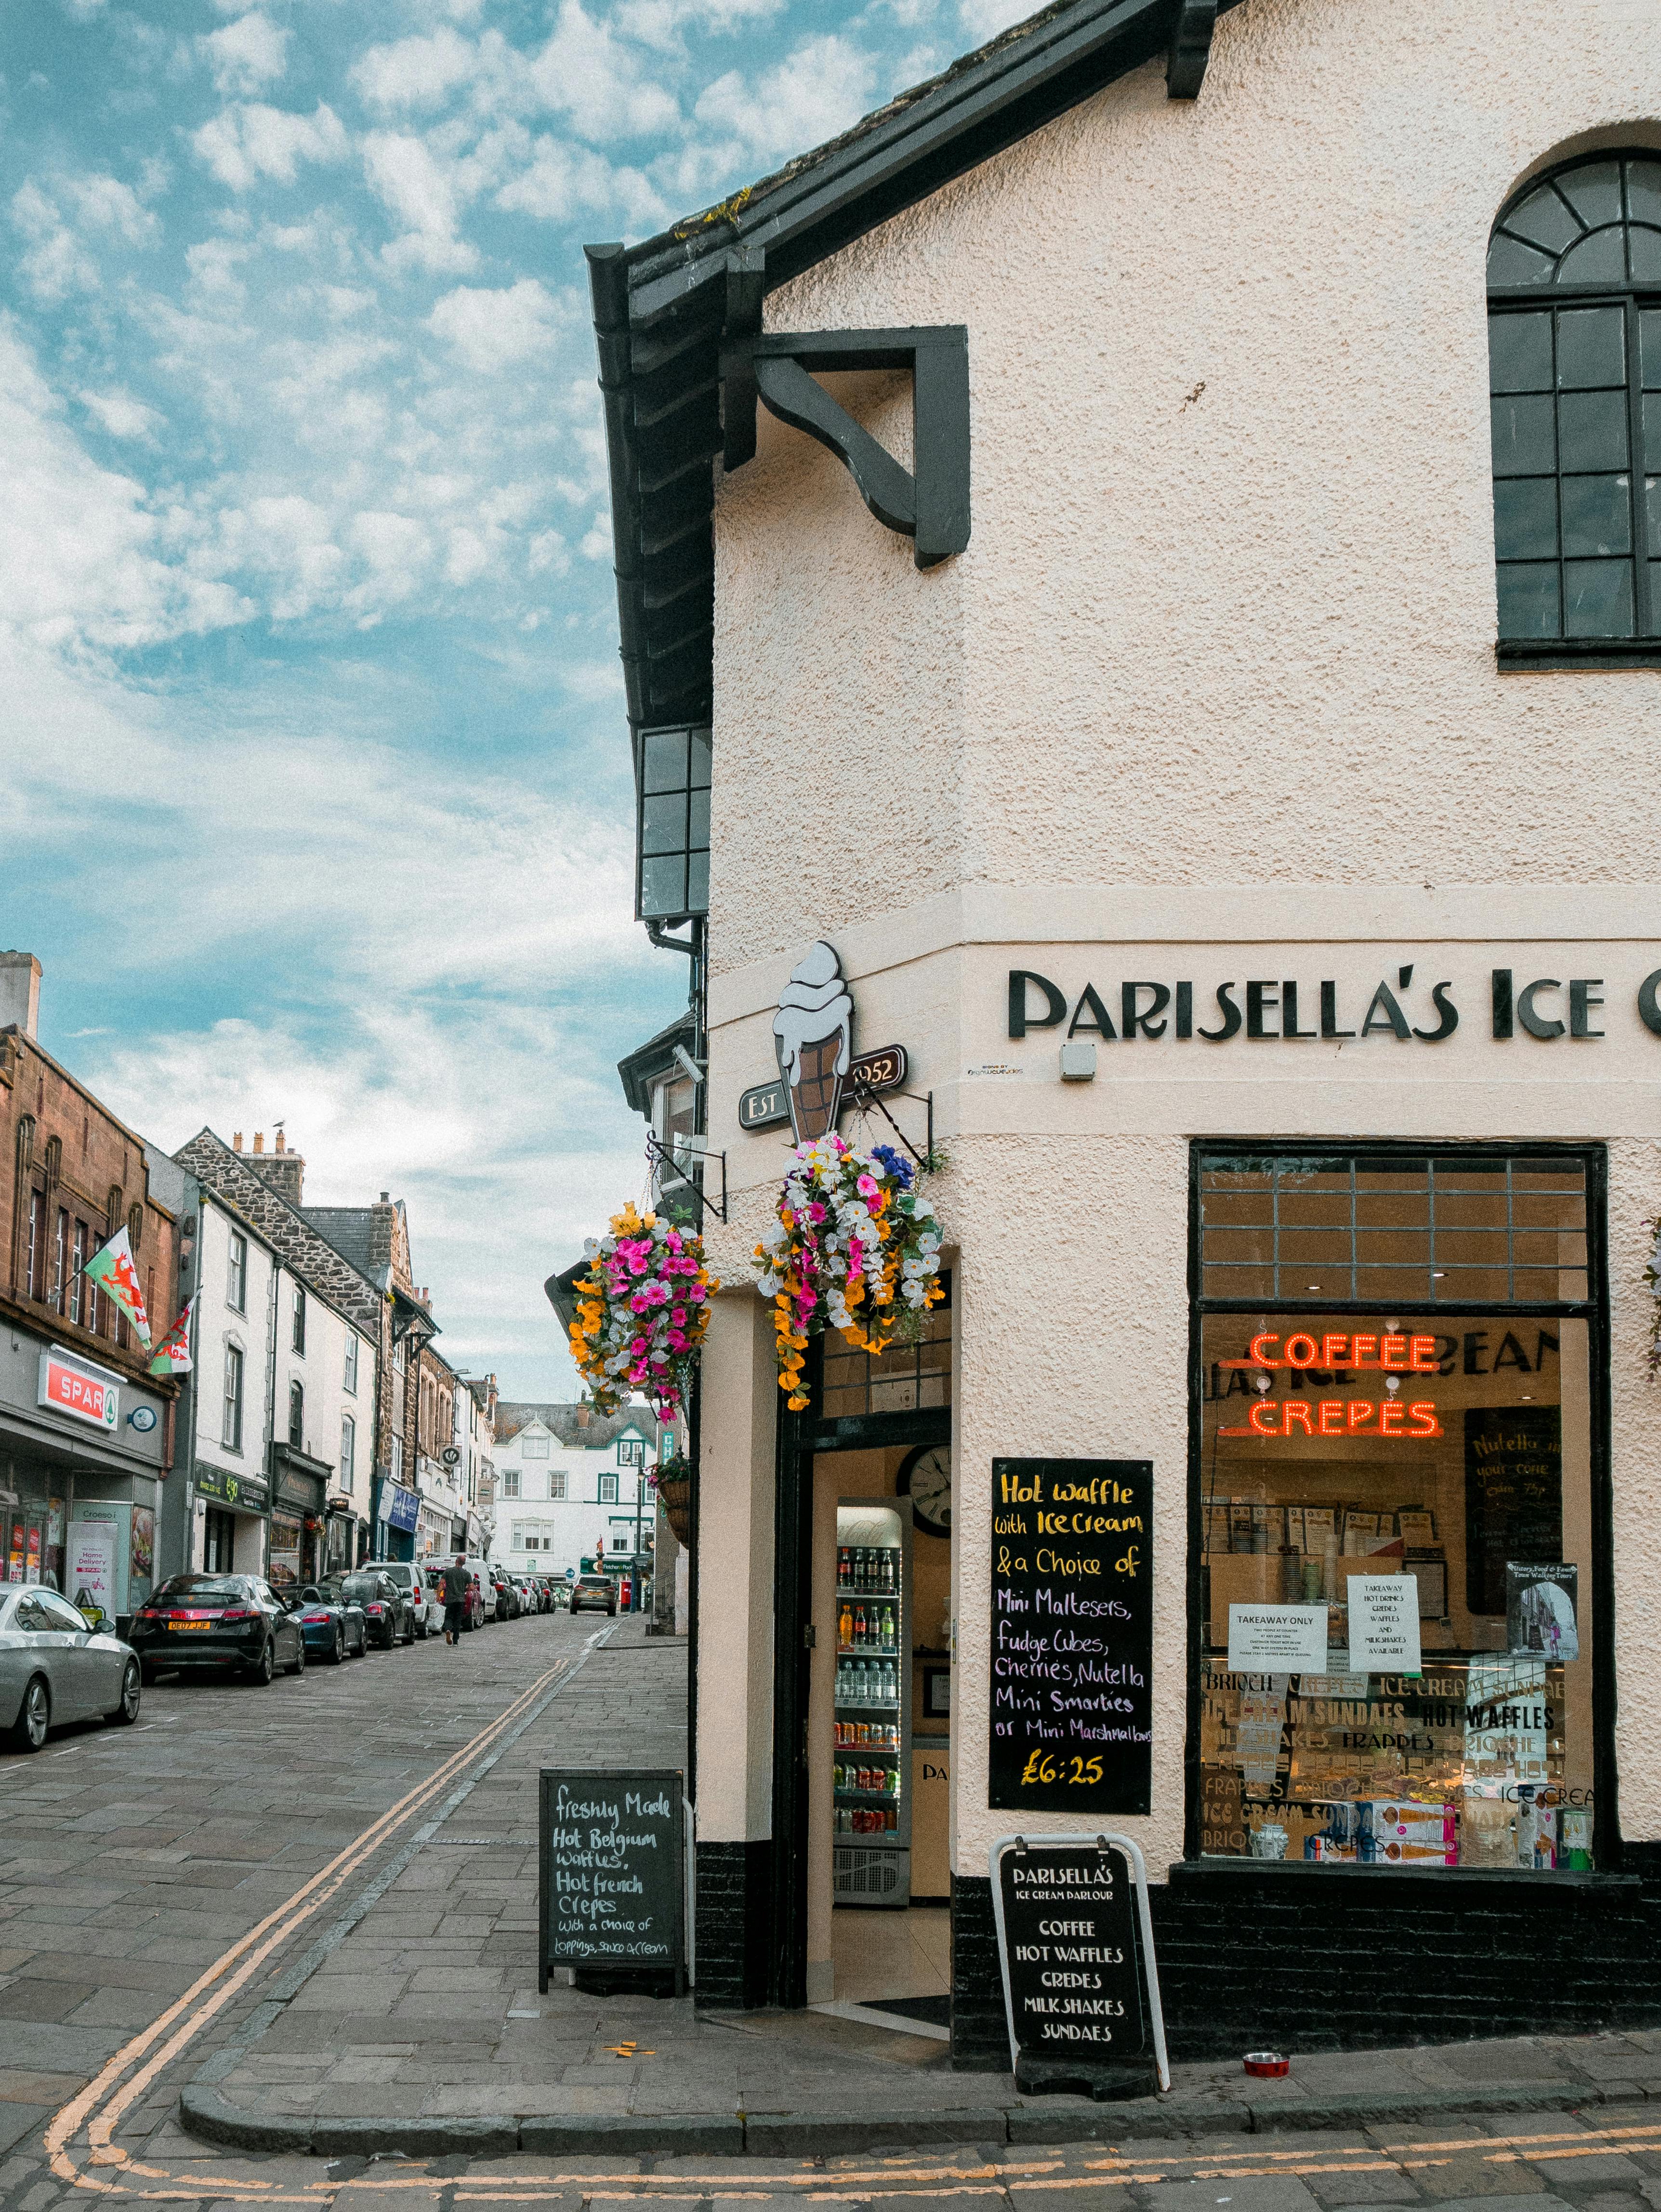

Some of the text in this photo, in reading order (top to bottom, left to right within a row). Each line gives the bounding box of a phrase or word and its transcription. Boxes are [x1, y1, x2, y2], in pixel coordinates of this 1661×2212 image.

[1008, 964, 1459, 1040] PARISELLA'S
[1492, 969, 1606, 1039] ICE
[1250, 1333, 1436, 1371] COFFEE
[61, 1375, 103, 1412] SPAR
[1249, 1400, 1438, 1437] CREPES
[1472, 1433, 1537, 1458] Nutella
[1477, 1464, 1549, 1488] your cone
[226, 1476, 238, 1502] ego
[1001, 1474, 1134, 1504] Hot waffle
[83, 1510, 112, 1519] Croeso
[995, 1514, 1027, 1534] with
[997, 1545, 1140, 1578] & a Choice of
[998, 1589, 1132, 1620] Mini Maltesers,
[1237, 1616, 1288, 1624] TAKEAWAY
[1054, 1629, 1108, 1656] Cubes,
[1079, 1660, 1144, 1687] Nutella
[1289, 1675, 1364, 1694] CREPES
[1381, 1677, 1411, 1696] ICE
[1416, 1678, 1485, 1697] CREAM
[996, 1685, 1134, 1712] Mini Smarties
[1205, 1698, 1554, 1730] ICE CREAM SUNDAES HOT WAFFLES
[995, 1721, 1014, 1736] or
[1026, 1719, 1064, 1738] Mini
[1343, 1733, 1434, 1750] FRAPPES
[625, 1791, 671, 1818] Made
[1501, 1786, 1535, 1804] ICE
[1203, 1802, 1233, 1824] ICE
[1240, 1803, 1304, 1824] CREAM
[553, 1827, 657, 1856] Hot Belgium
[1308, 1833, 1385, 1853] CREPES
[556, 1870, 591, 1893] Hot
[1014, 1865, 1113, 1884] PARISELLA'S
[1016, 1891, 1113, 1901] ICE CREAM PARLOUR
[559, 1896, 617, 1920] Crepes
[589, 1922, 597, 1931] a
[638, 1917, 654, 1931] of
[1039, 1920, 1095, 1936] COFFEE
[1016, 1946, 1124, 1964] HOT WAFFLES
[1041, 1972, 1102, 1989] CREPES
[1041, 2023, 1112, 2042] SUNDAES
